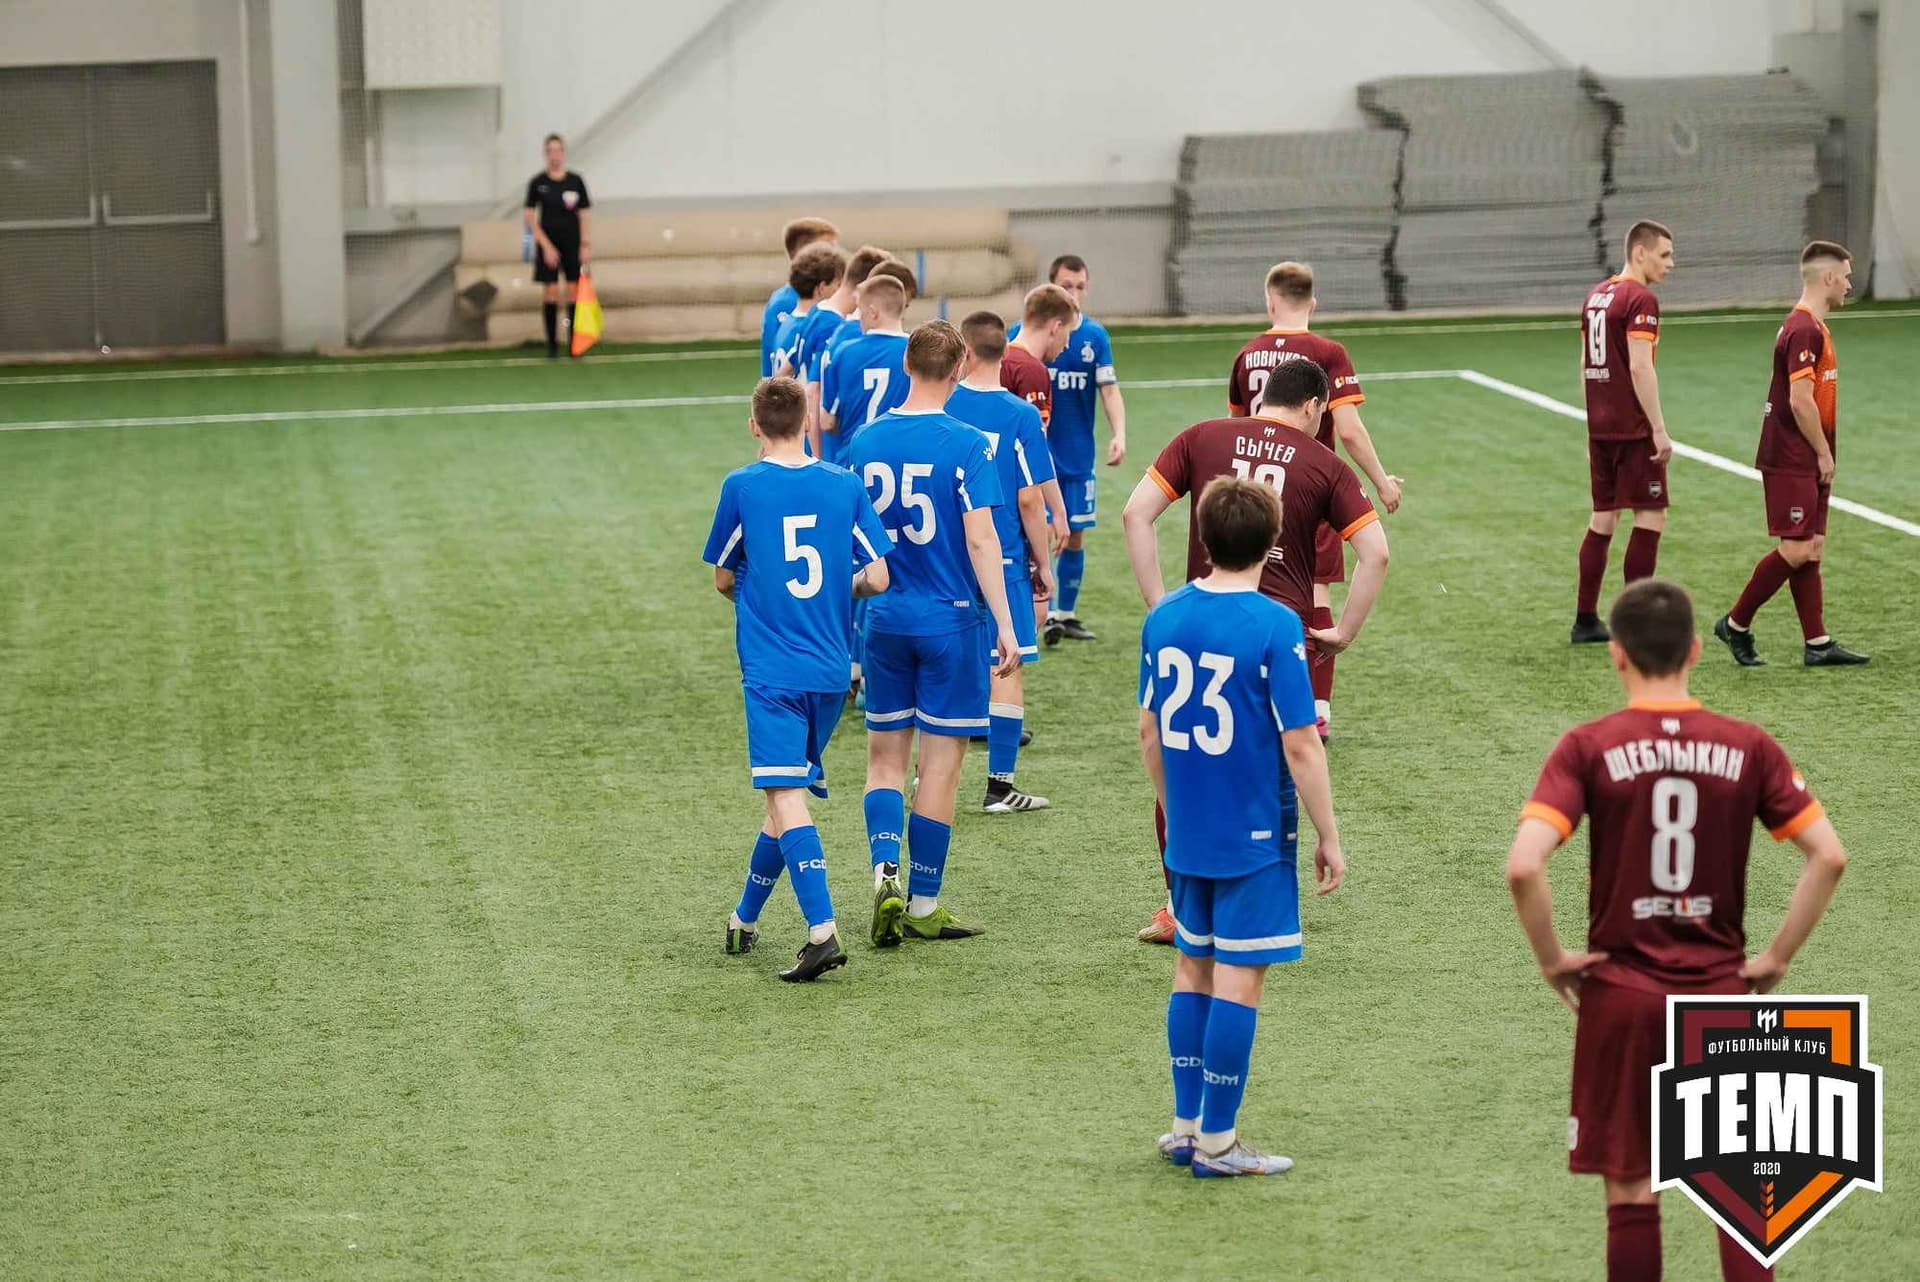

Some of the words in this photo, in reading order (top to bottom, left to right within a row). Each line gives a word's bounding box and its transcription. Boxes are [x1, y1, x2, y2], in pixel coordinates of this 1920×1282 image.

[863, 368, 891, 424] 7
[1058, 371, 1088, 390] ВТБ
[1236, 435, 1296, 464] СЫЧЕВ
[863, 461, 937, 545] 25
[782, 514, 824, 599] 5
[1157, 646, 1235, 756] 23
[1603, 738, 1745, 782] ЩЕБЛЫКИН
[1650, 776, 1698, 893] 8
